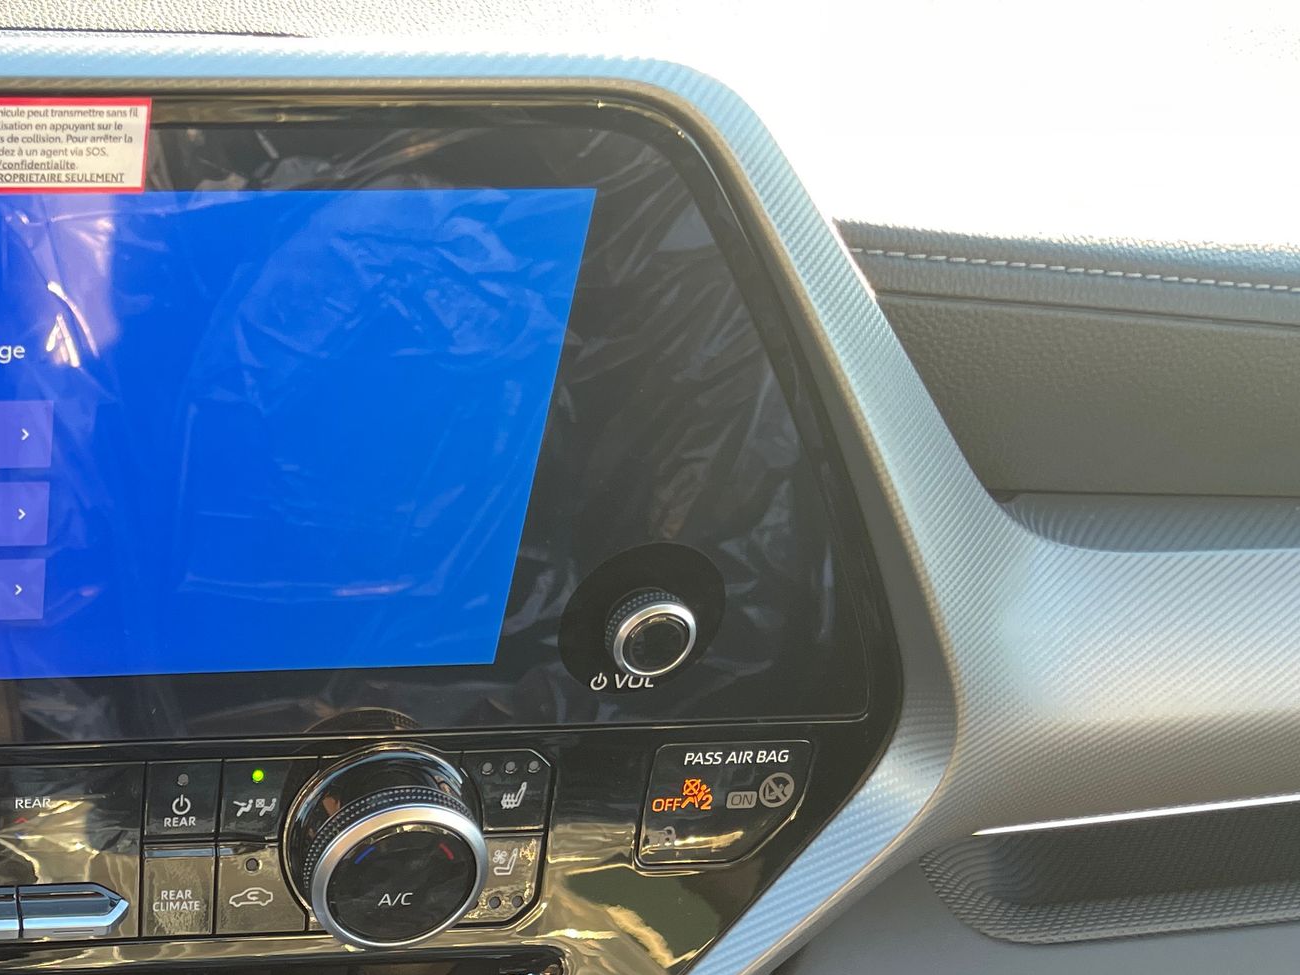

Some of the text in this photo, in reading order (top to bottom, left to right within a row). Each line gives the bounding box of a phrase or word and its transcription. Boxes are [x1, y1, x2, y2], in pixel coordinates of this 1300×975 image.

[27, 109, 48, 118] peut
[50, 109, 104, 117] transmettre
[129, 106, 137, 117] fil
[49, 123, 95, 132] appuyant
[114, 122, 122, 130] le
[64, 173, 124, 182] SEULEMENT
[614, 674, 654, 688] VOL
[684, 750, 790, 766] PASS AIR BAG
[15, 797, 51, 810] REAR
[652, 798, 682, 812] OFF
[163, 816, 196, 828] REAR
[160, 890, 192, 901] REAR
[378, 892, 413, 906] A/C
[152, 900, 200, 912] CLIMATE
